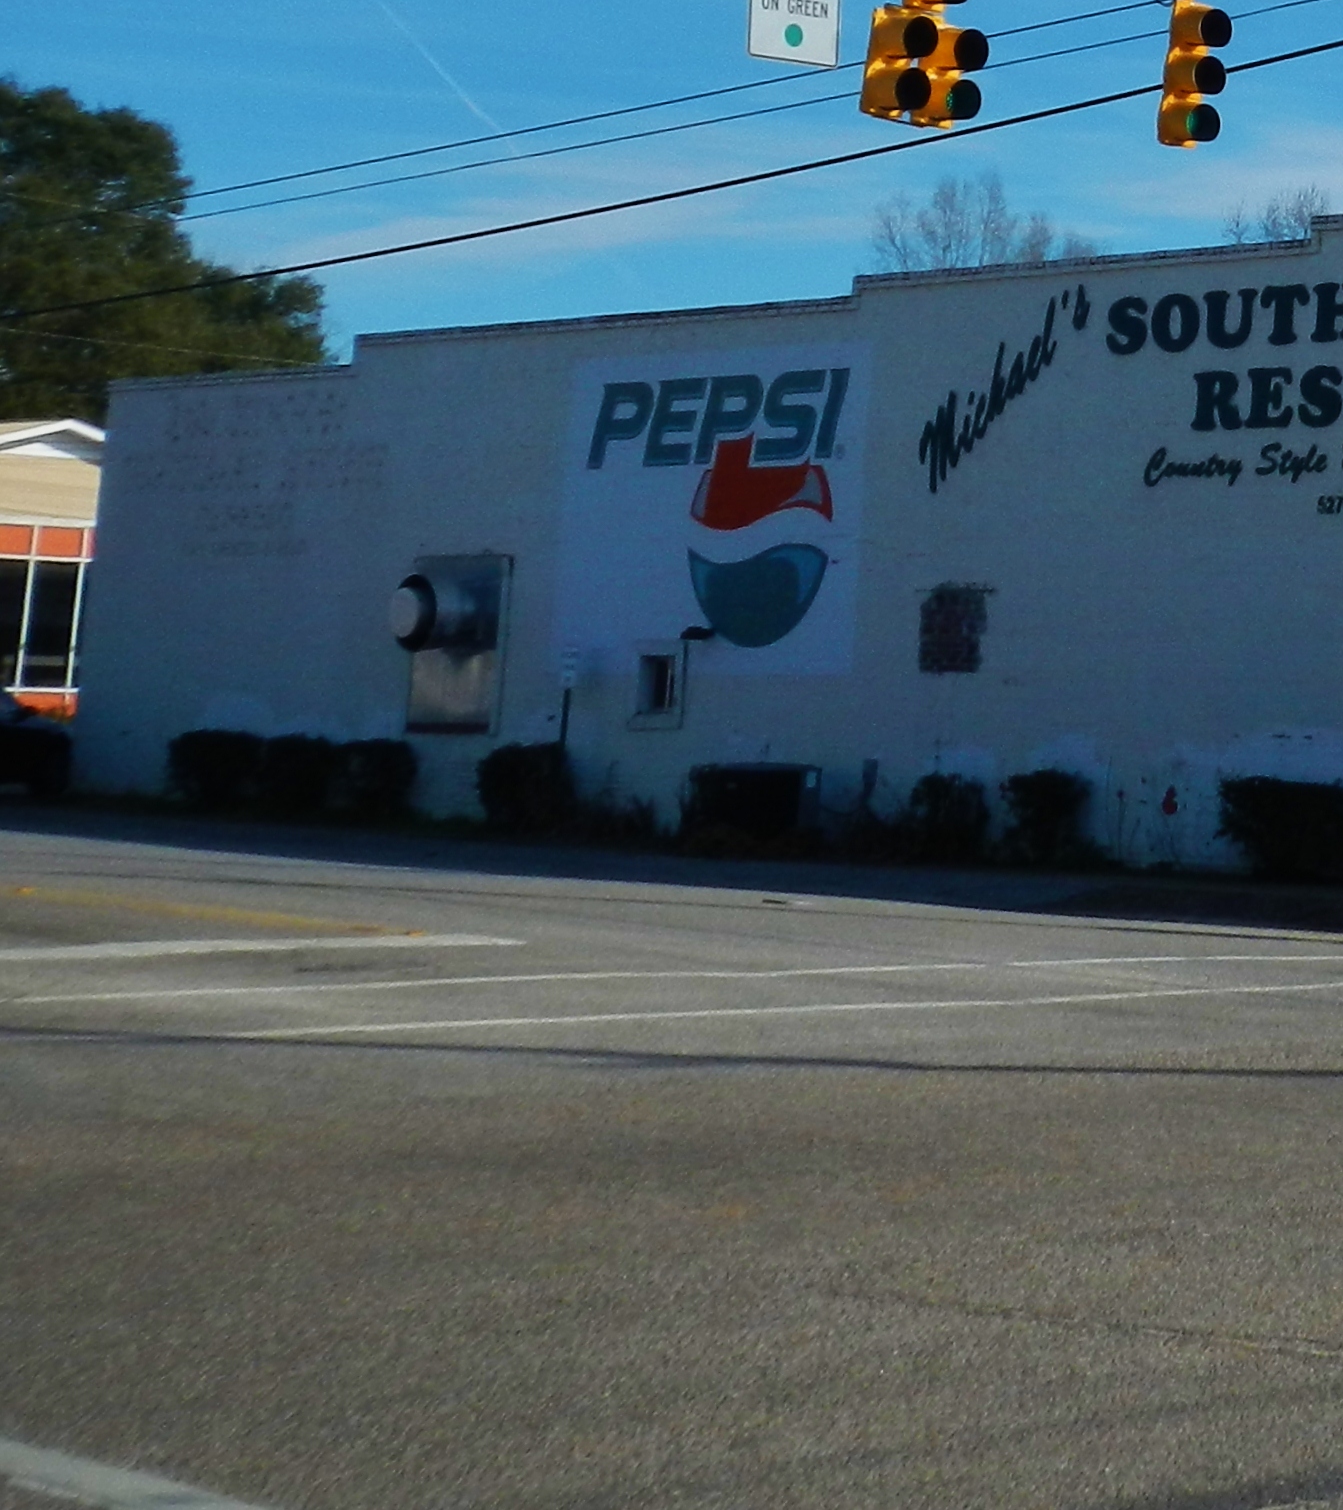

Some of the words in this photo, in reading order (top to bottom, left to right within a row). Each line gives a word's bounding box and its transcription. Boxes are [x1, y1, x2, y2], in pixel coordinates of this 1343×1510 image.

[586, 367, 850, 470] PEPSI
[919, 284, 1090, 492] Michael's
[1143, 446, 1243, 487] Country
[1255, 441, 1327, 483] Style
